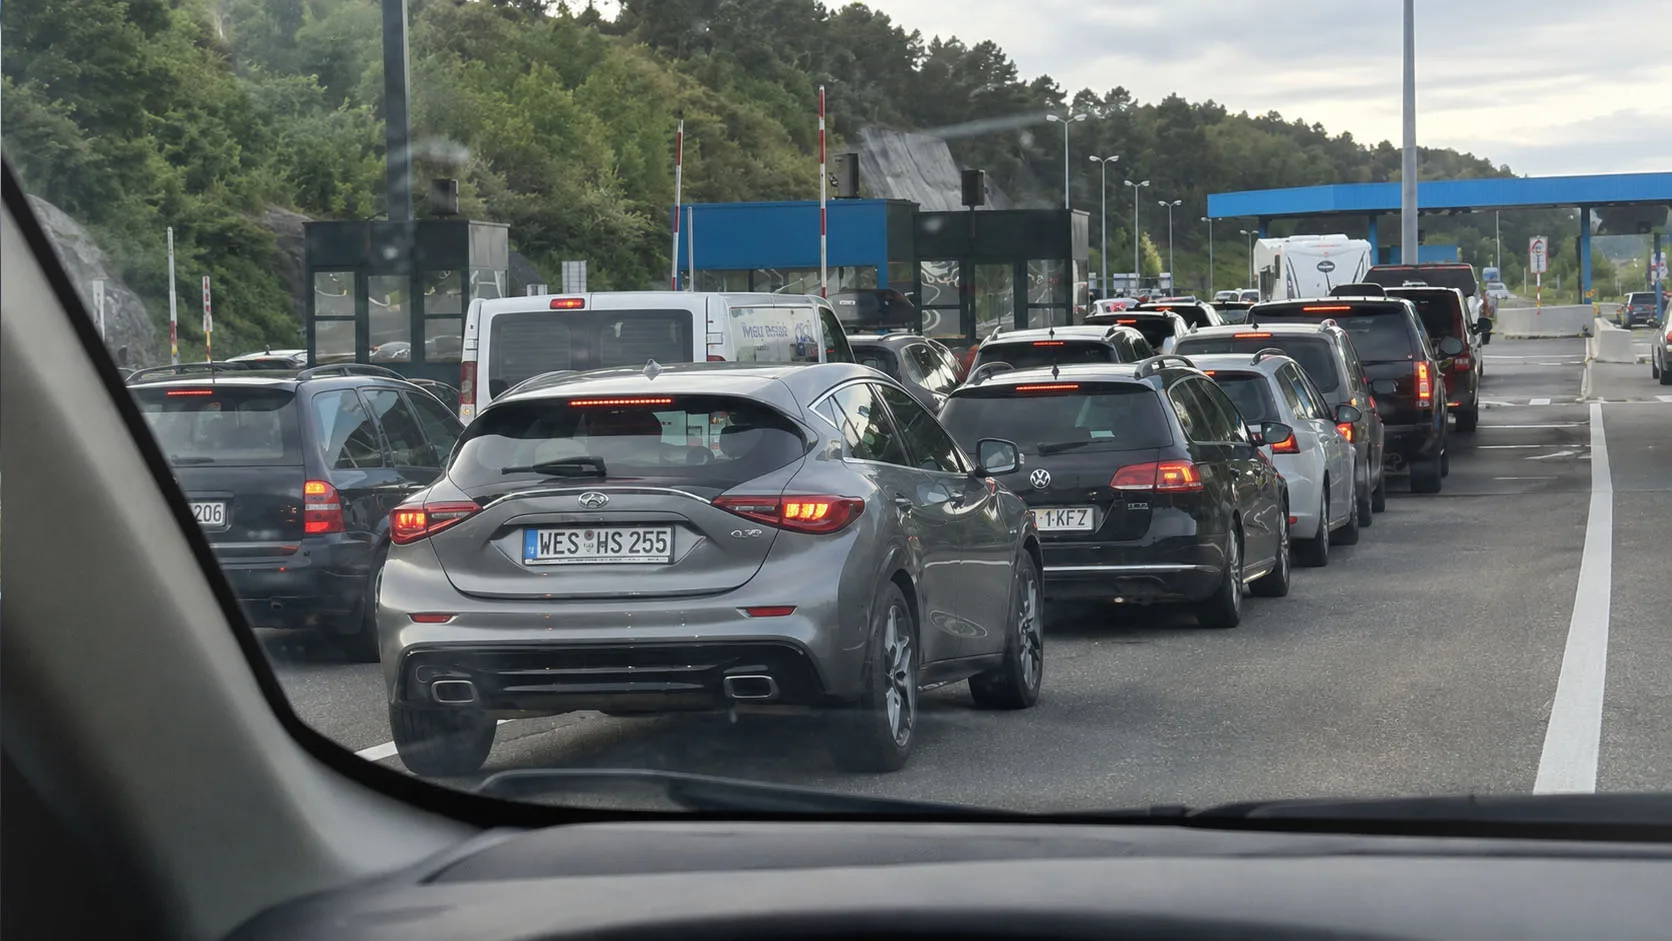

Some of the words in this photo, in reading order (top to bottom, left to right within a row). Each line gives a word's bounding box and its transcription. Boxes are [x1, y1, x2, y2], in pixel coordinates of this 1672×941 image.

[194, 504, 222, 522] 206
[539, 531, 580, 555] WES
[596, 531, 623, 554] HS
[628, 530, 668, 554] 255
